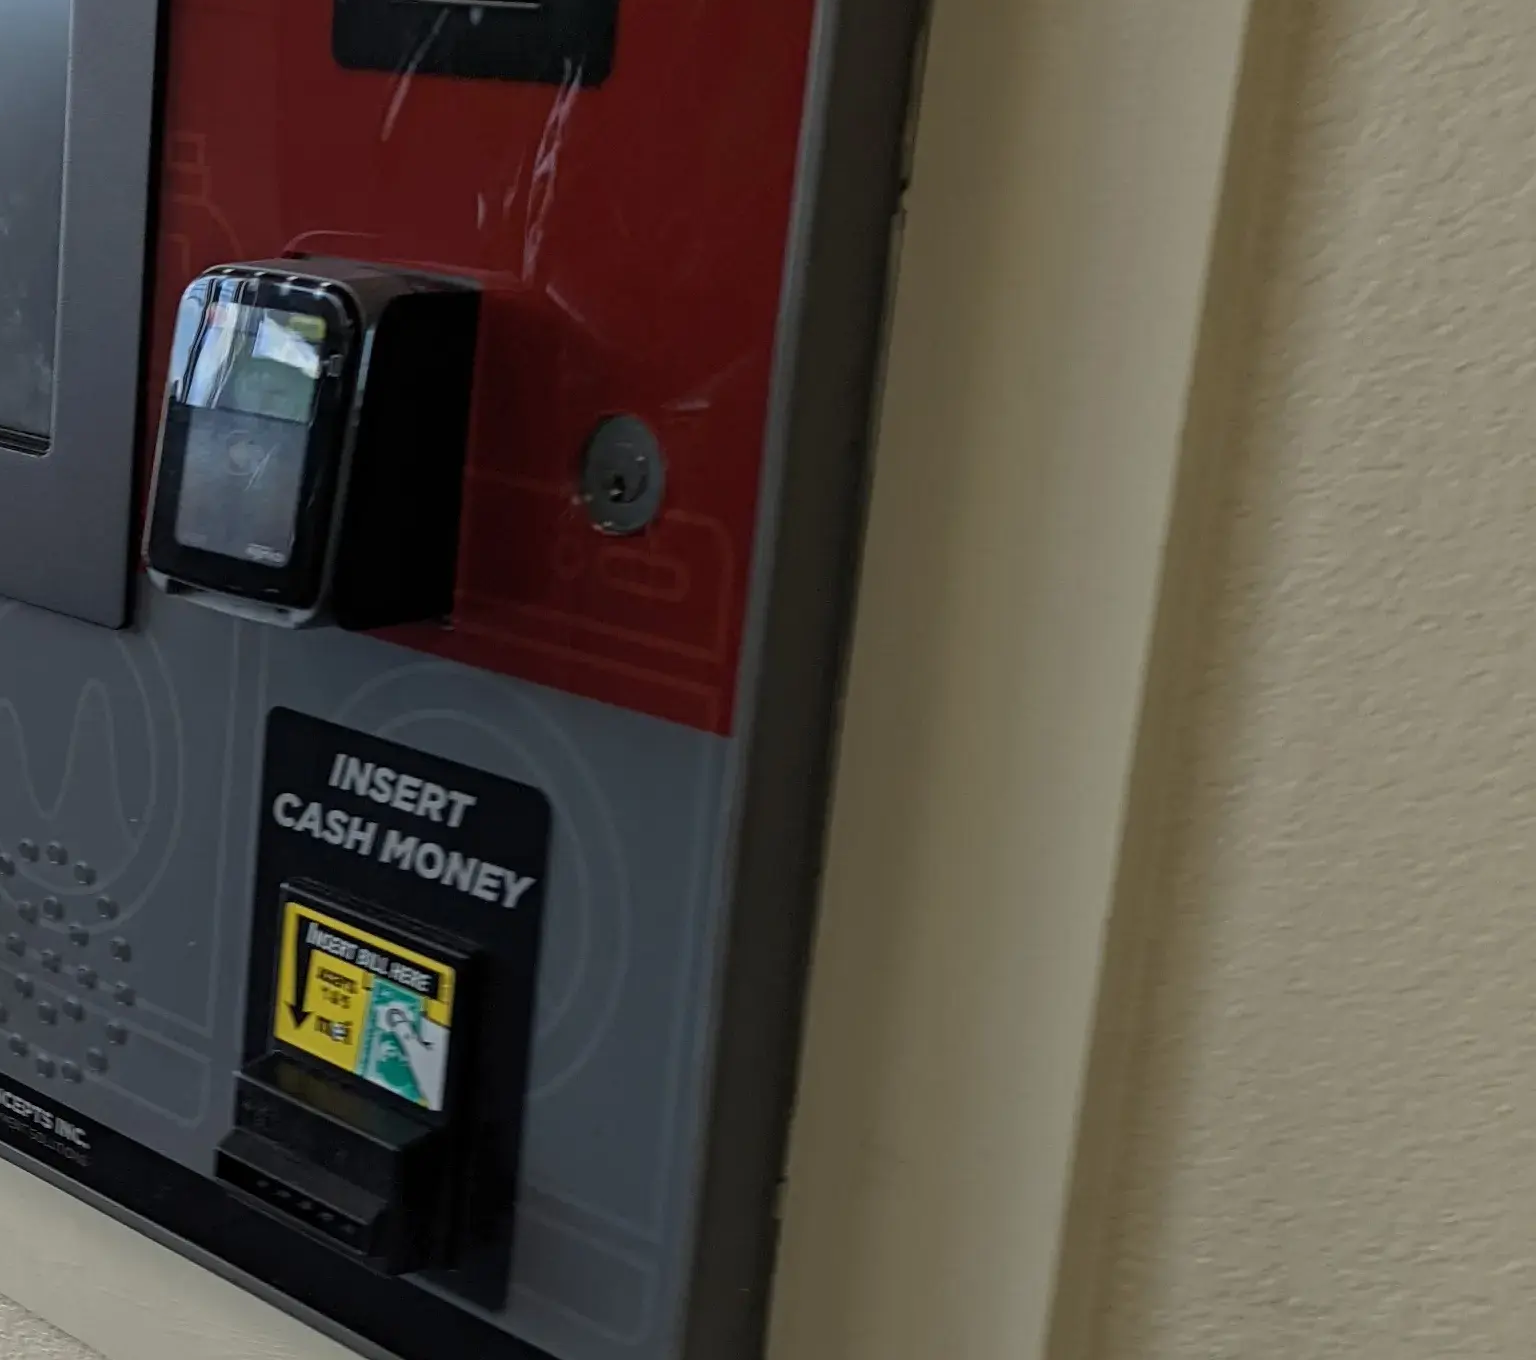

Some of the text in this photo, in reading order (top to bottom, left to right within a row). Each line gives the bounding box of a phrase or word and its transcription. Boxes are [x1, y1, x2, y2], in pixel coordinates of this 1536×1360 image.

[329, 753, 476, 828] INSERT
[273, 793, 537, 909] CASH MONEY
[54, 1116, 92, 1151] INC.
